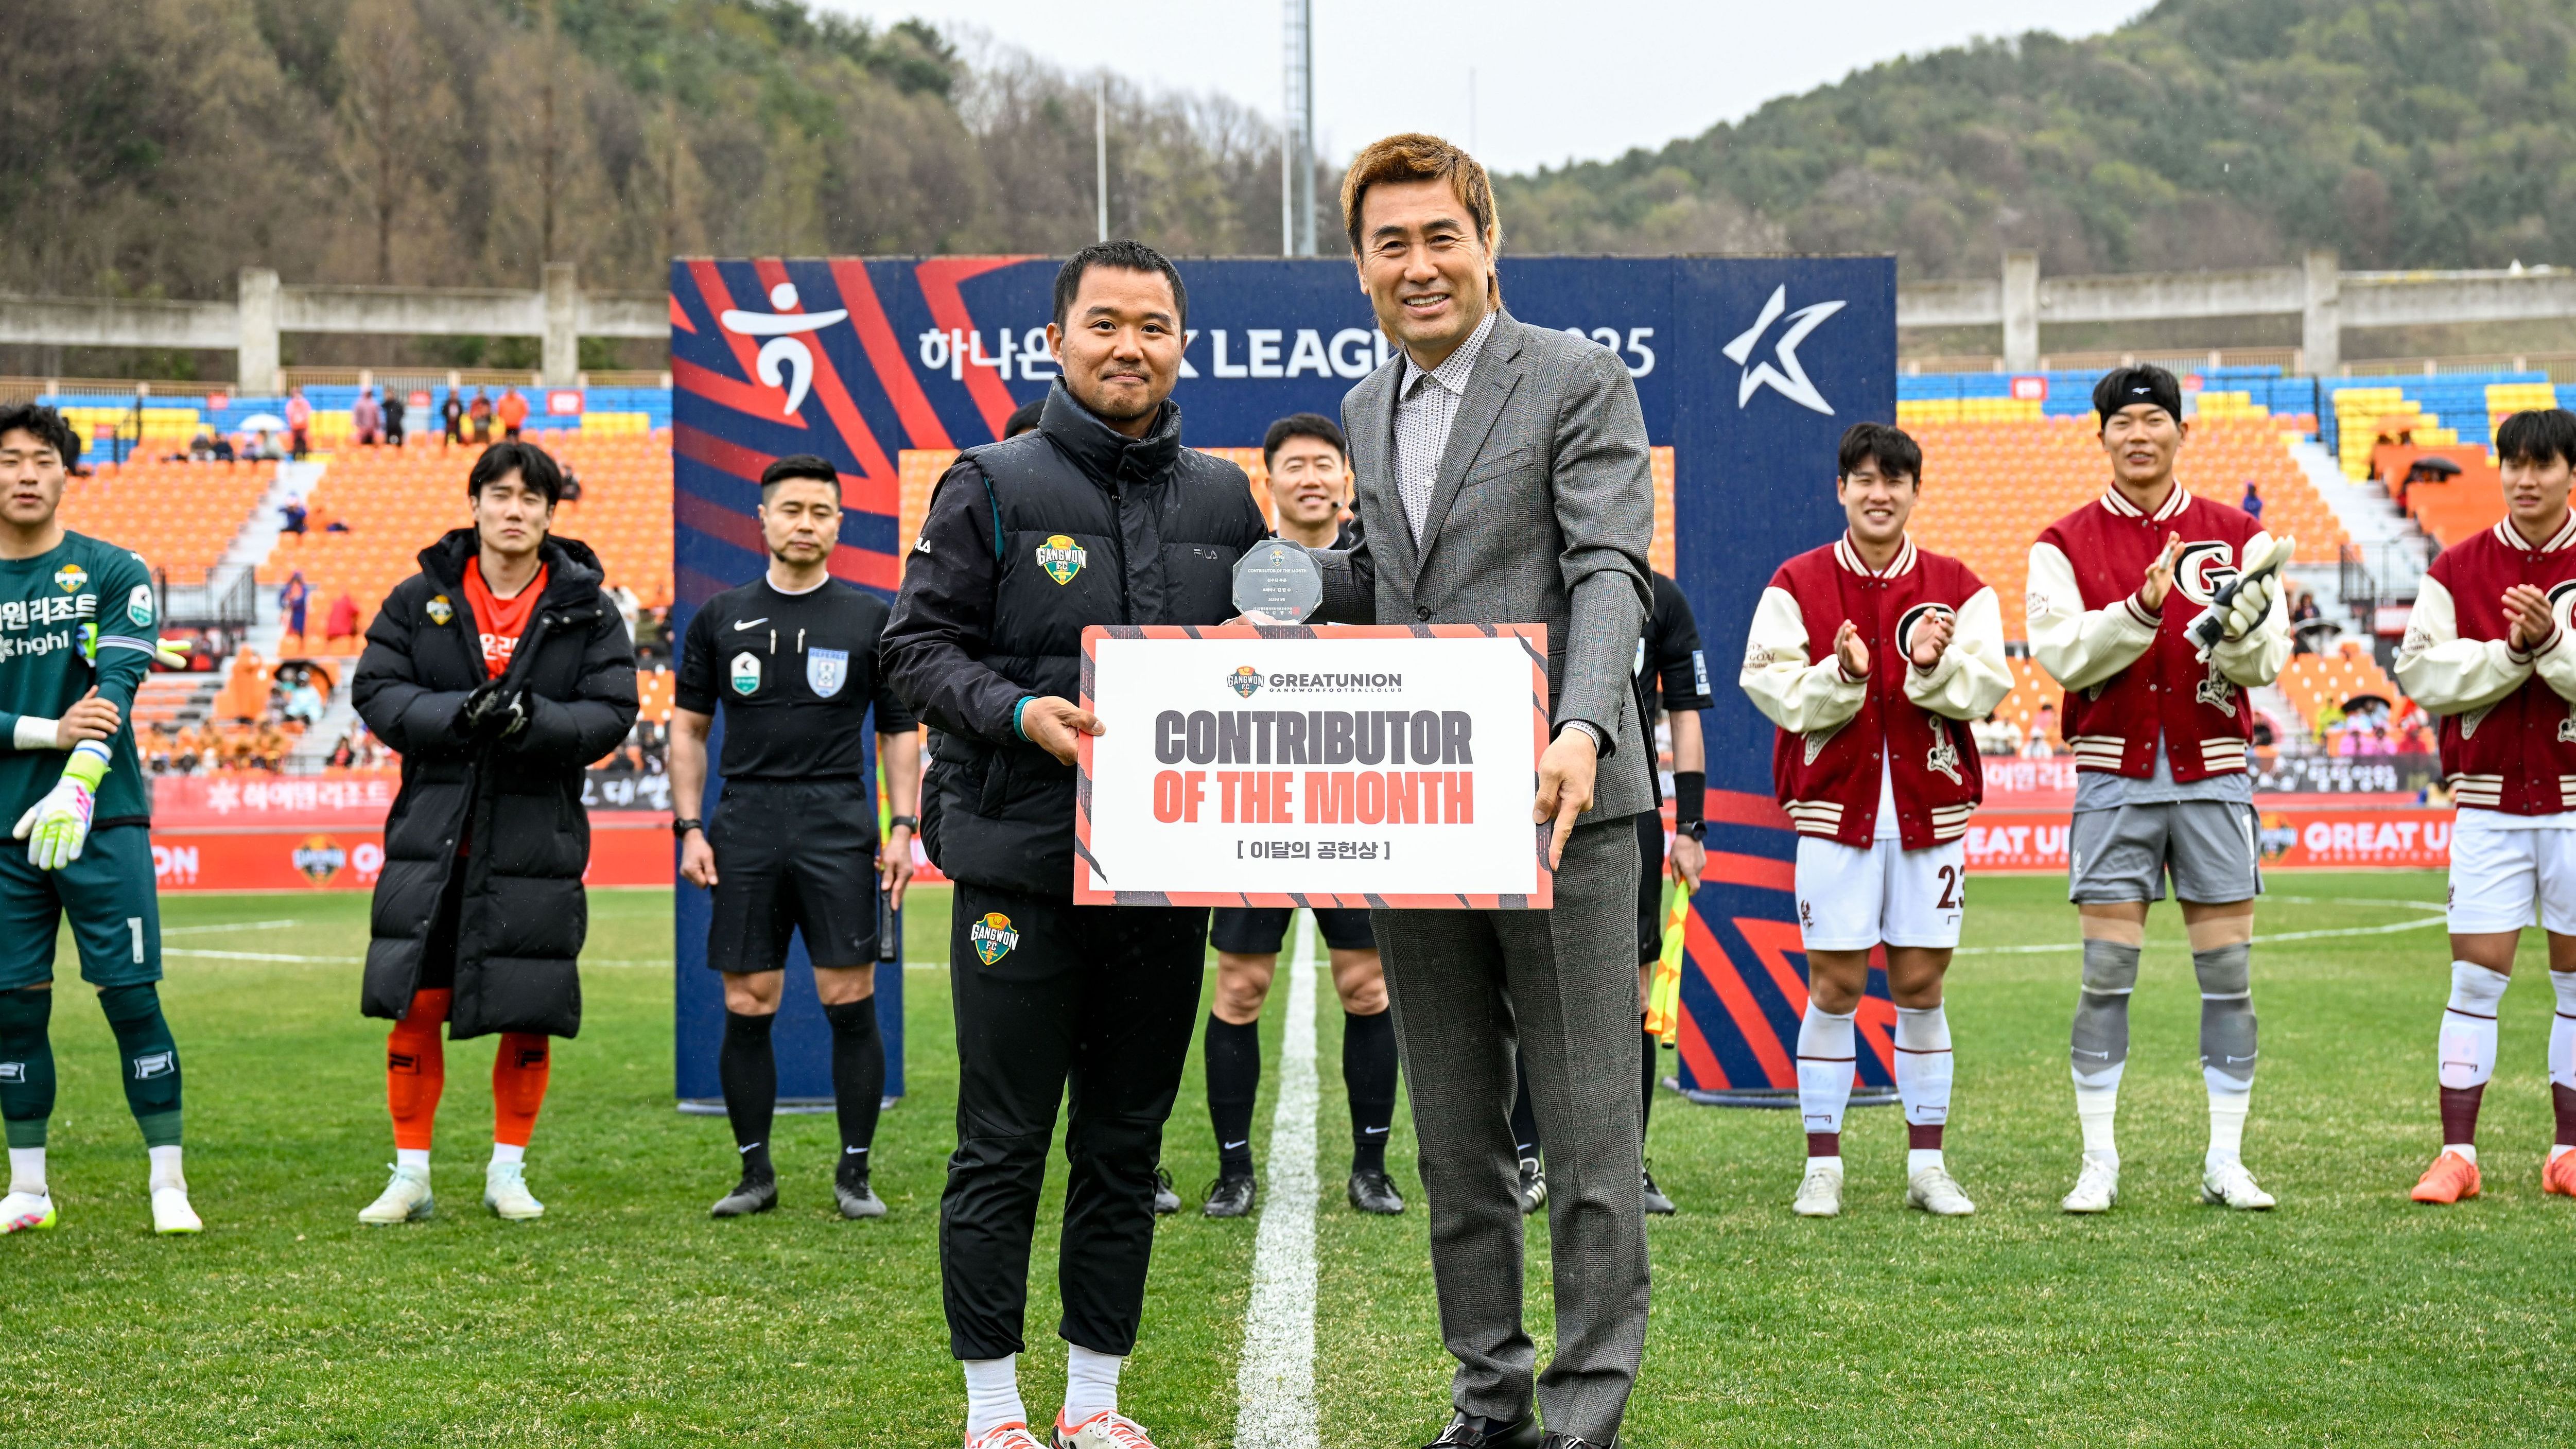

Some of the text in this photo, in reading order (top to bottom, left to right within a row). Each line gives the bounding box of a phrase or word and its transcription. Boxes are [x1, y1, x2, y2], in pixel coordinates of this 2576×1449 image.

[1036, 548, 1087, 568] GANGWON
[1056, 561, 1069, 571] FC
[1193, 548, 1219, 560] FILA
[0, 593, 97, 631] 원리조트
[1227, 673, 1402, 688] GANGWON GREATUNION
[1155, 710, 1473, 765] CONTRIBUTOR
[1153, 770, 1474, 825] OF THE MONTH
[1250, 841, 1310, 859] 이달의
[1317, 841, 1379, 859] 공헌상
[1963, 826, 2031, 855] EAT
[127, 917, 144, 964] 1
[970, 923, 1019, 951] GANGWON
[986, 941, 997, 951] FC
